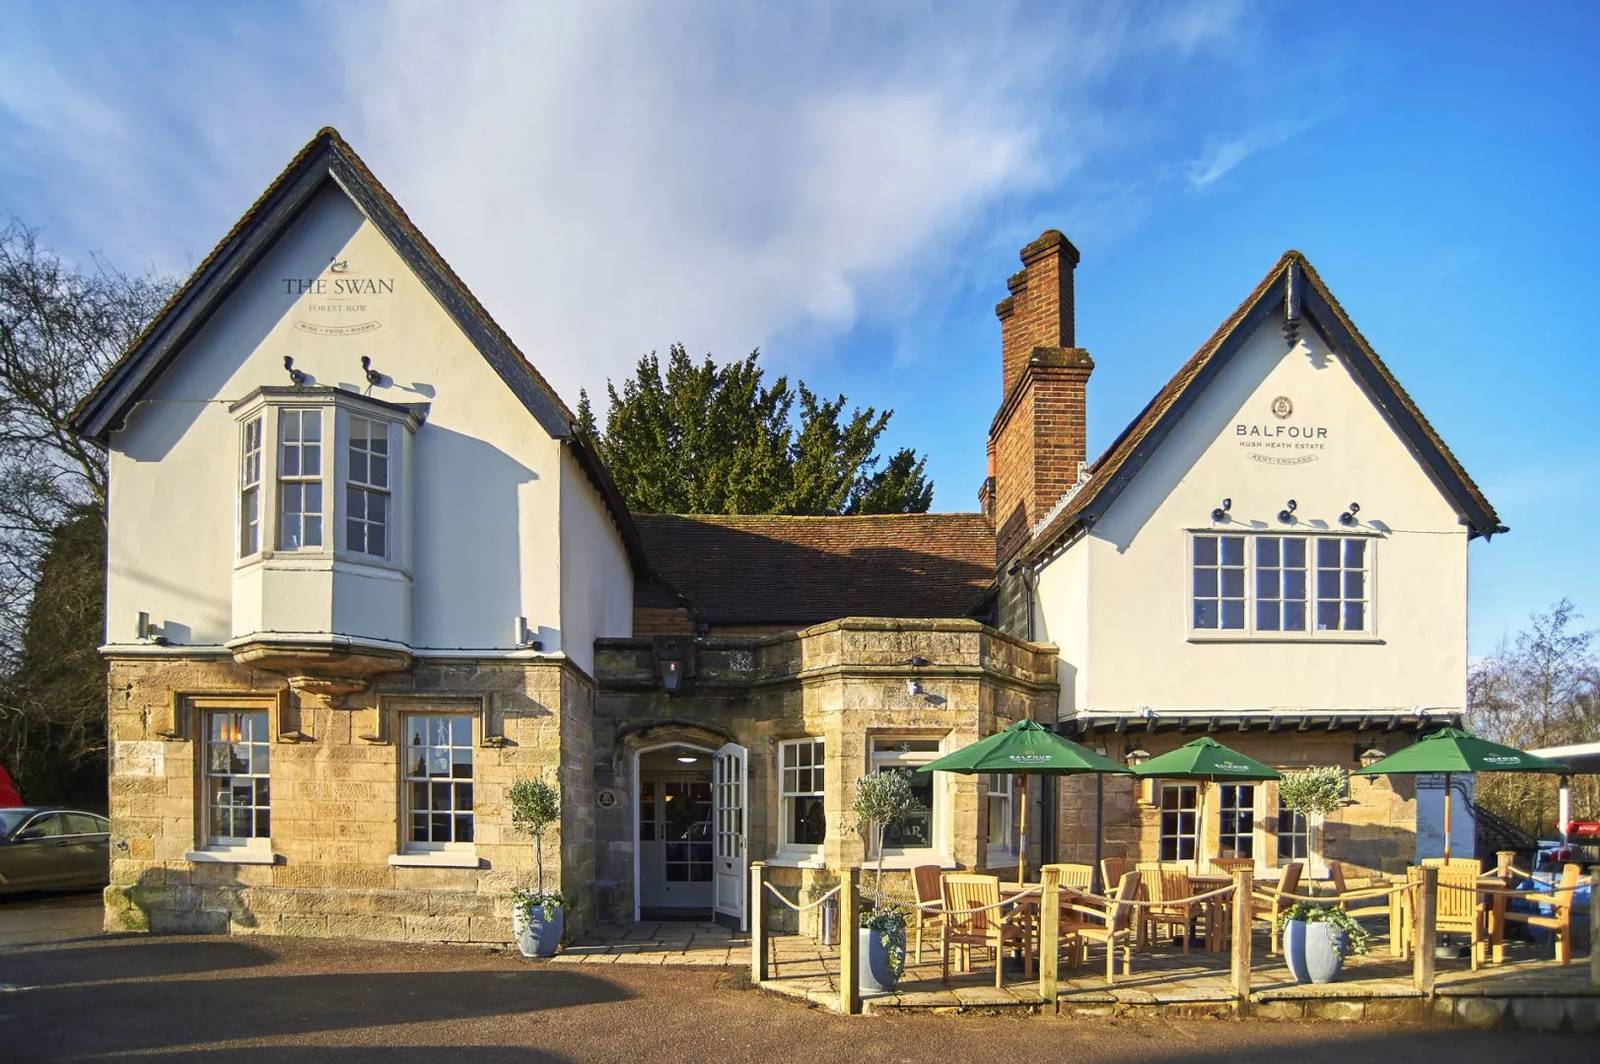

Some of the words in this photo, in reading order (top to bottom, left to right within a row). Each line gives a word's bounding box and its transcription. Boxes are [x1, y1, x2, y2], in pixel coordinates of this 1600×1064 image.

[281, 279, 327, 295] THE
[334, 279, 395, 295] SWAN
[1236, 424, 1328, 439] BALFOUR
